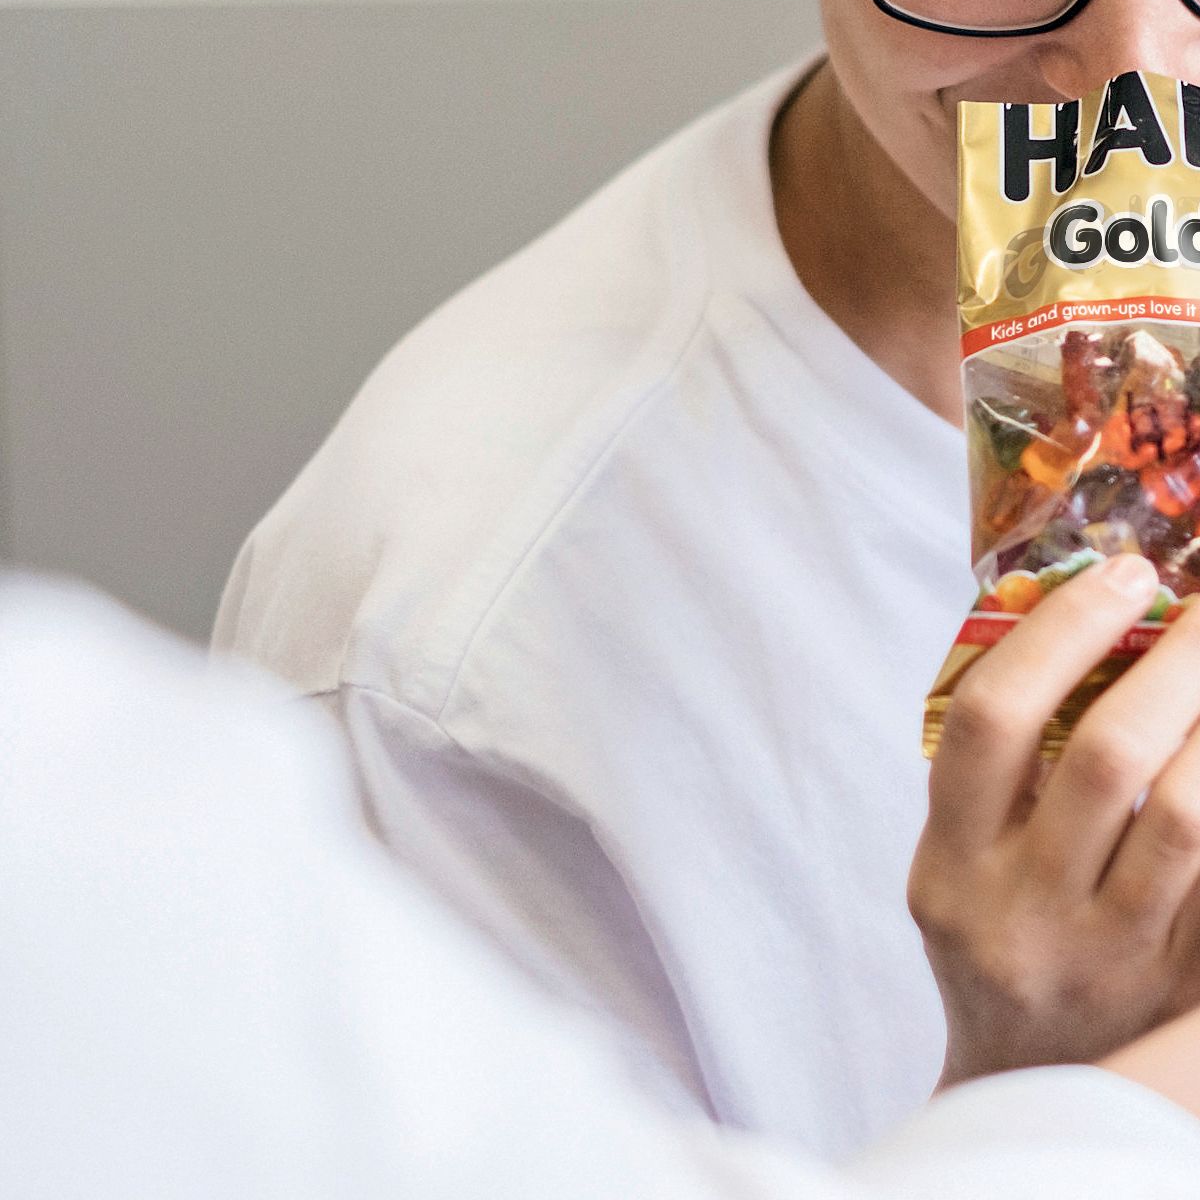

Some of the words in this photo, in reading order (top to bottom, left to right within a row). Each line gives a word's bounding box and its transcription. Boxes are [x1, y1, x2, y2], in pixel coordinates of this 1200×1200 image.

[991, 320, 1024, 341] Kids
[1028, 304, 1059, 329] and
[1062, 301, 1146, 321] grown-ups
[1150, 300, 1182, 316] love
[1186, 301, 1197, 317] it
